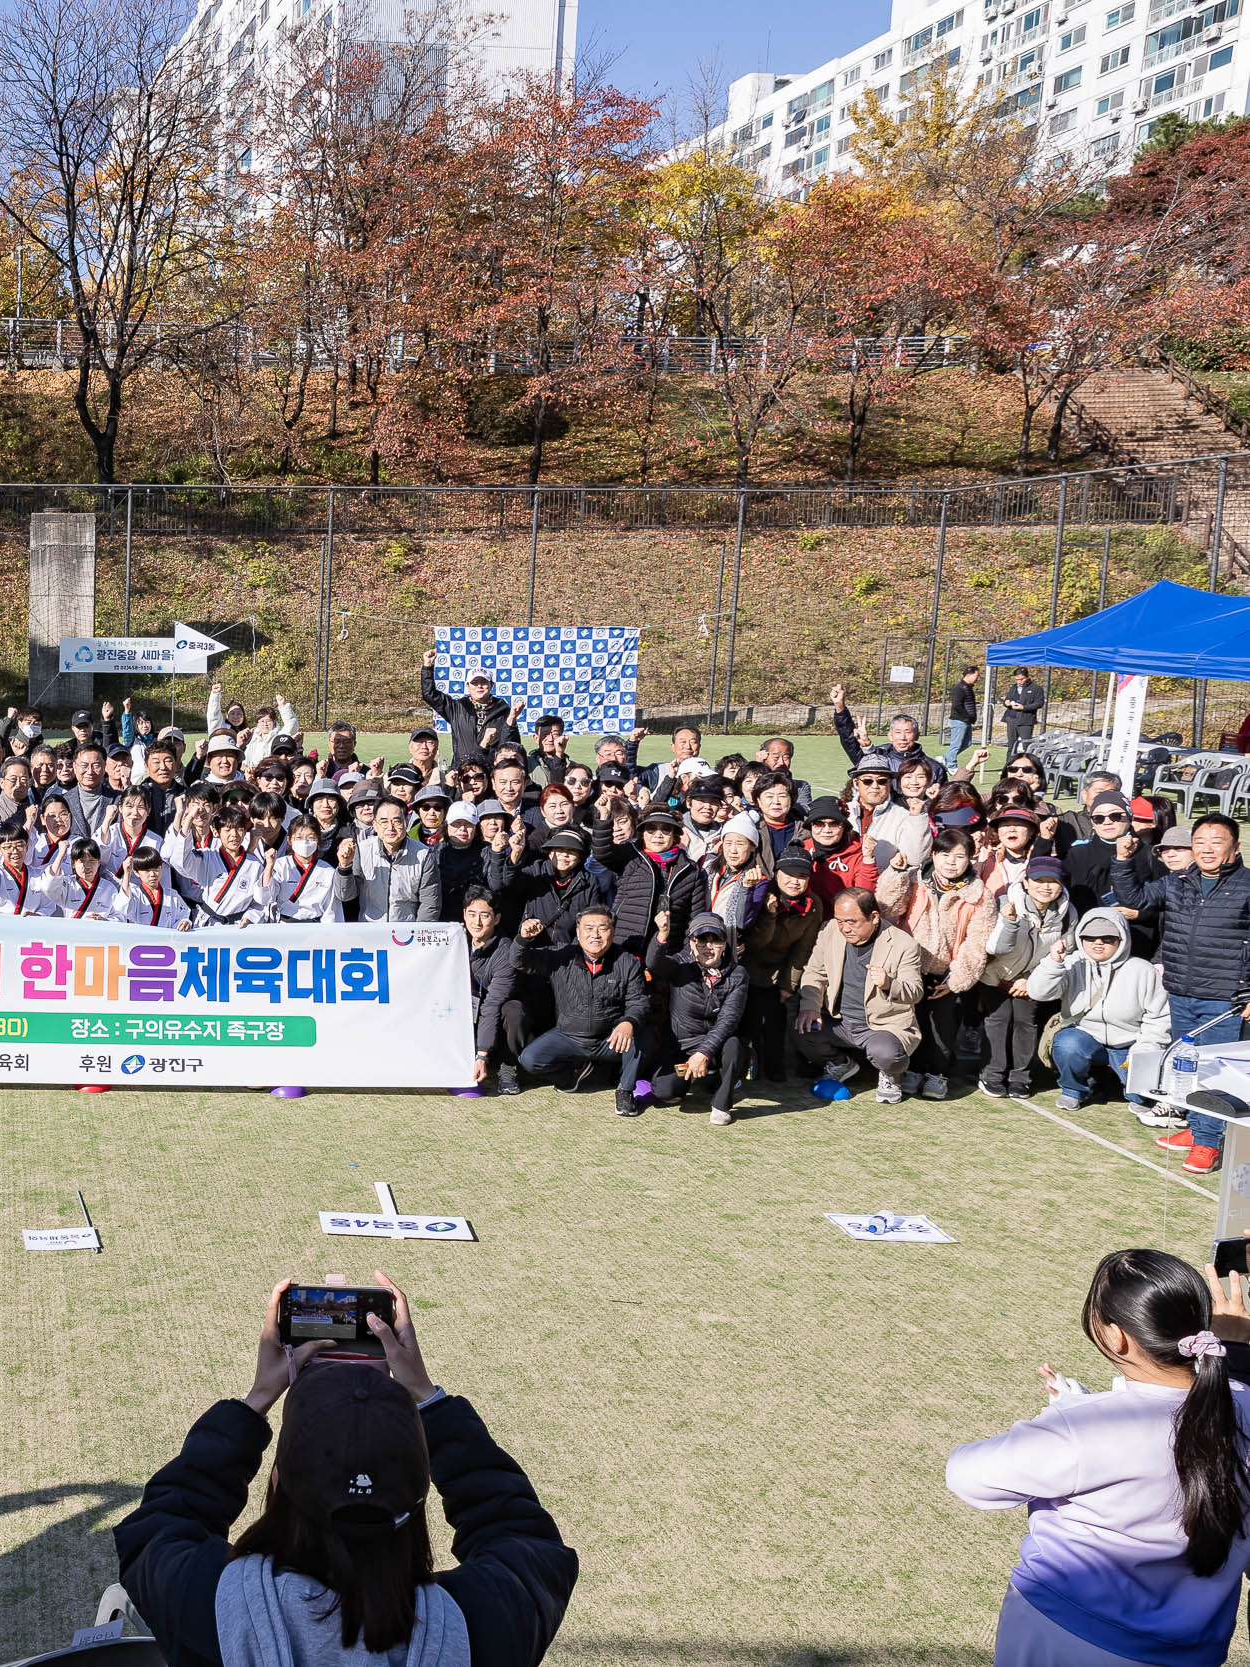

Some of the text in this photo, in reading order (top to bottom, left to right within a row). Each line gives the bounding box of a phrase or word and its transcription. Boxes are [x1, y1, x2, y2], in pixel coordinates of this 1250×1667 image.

[96, 649, 175, 661] 광진중앙 새마을
[188, 641, 216, 651] 중곡3동
[20, 940, 391, 1004] 한마음체육대회
[70, 1017, 110, 1040] 장소
[125, 1018, 222, 1041] 구의유수지
[226, 1020, 285, 1042] 족구장
[80, 1053, 204, 1075] 후원 광진구
[329, 1218, 420, 1232] 중곡4동
